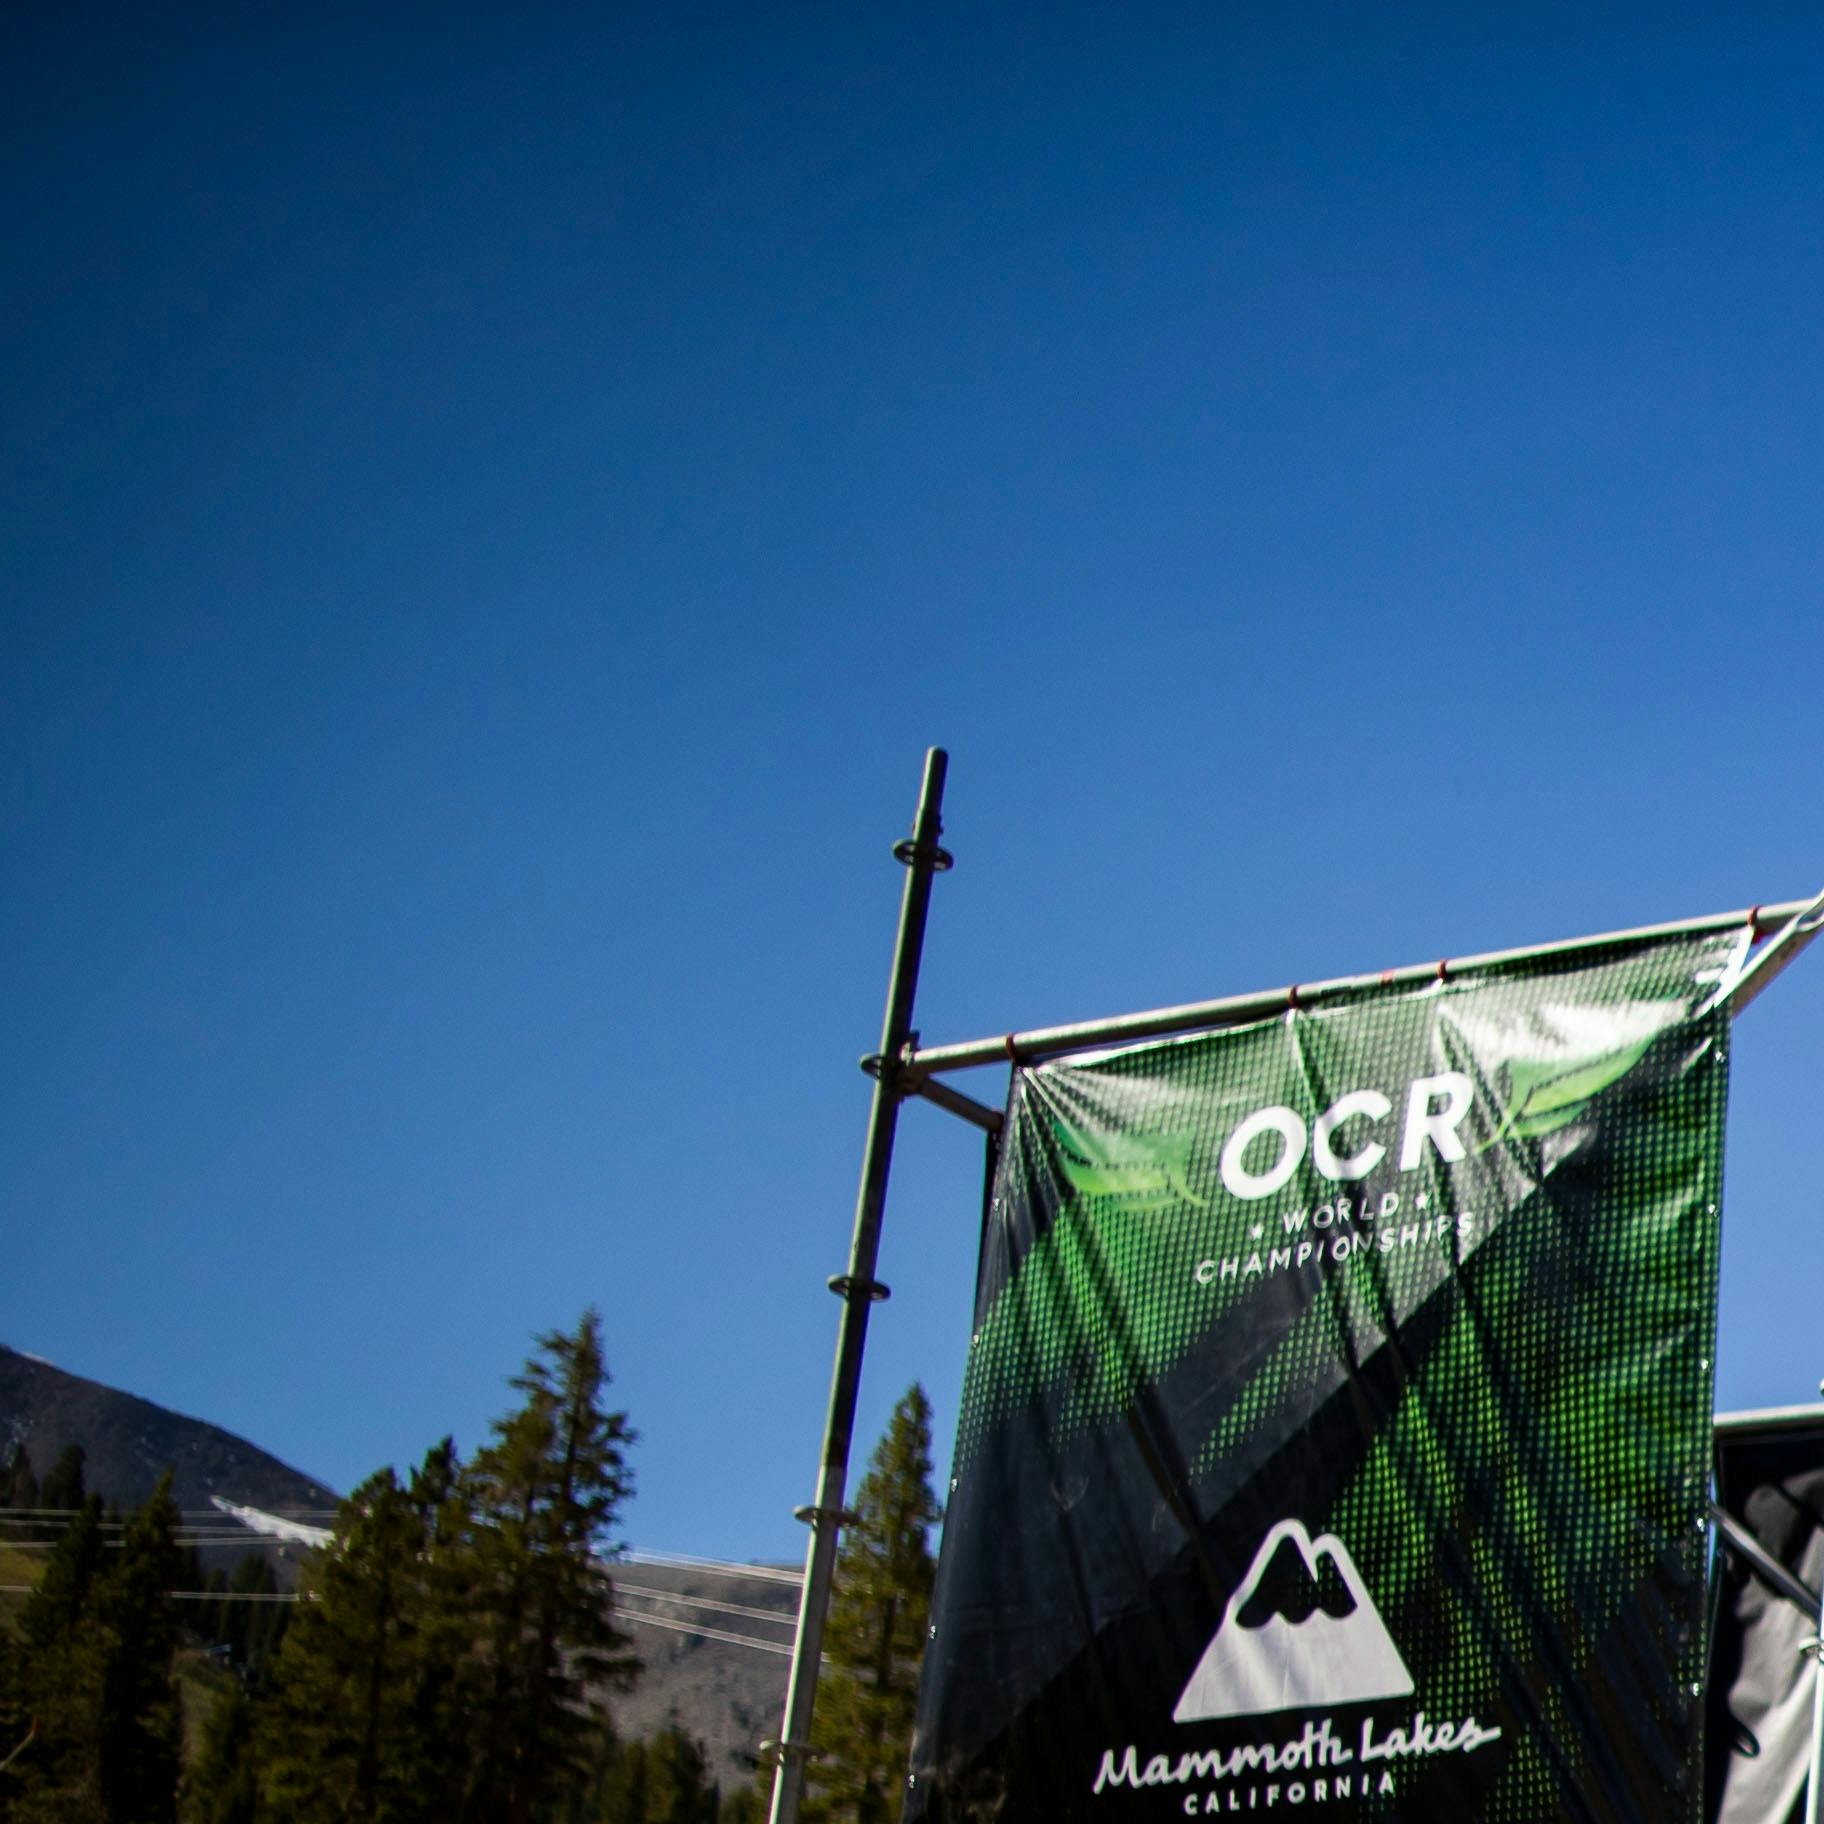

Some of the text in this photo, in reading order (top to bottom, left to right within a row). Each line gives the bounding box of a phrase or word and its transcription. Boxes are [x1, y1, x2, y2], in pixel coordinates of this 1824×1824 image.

[1220, 1070, 1474, 1200] OCR
[1195, 1212, 1474, 1285] CHAMPIONSHIPS
[1282, 1191, 1401, 1234] WORLD
[1093, 1714, 1501, 1794] Mammoth Lakes
[1183, 1772, 1397, 1816] CALIFORNIA
